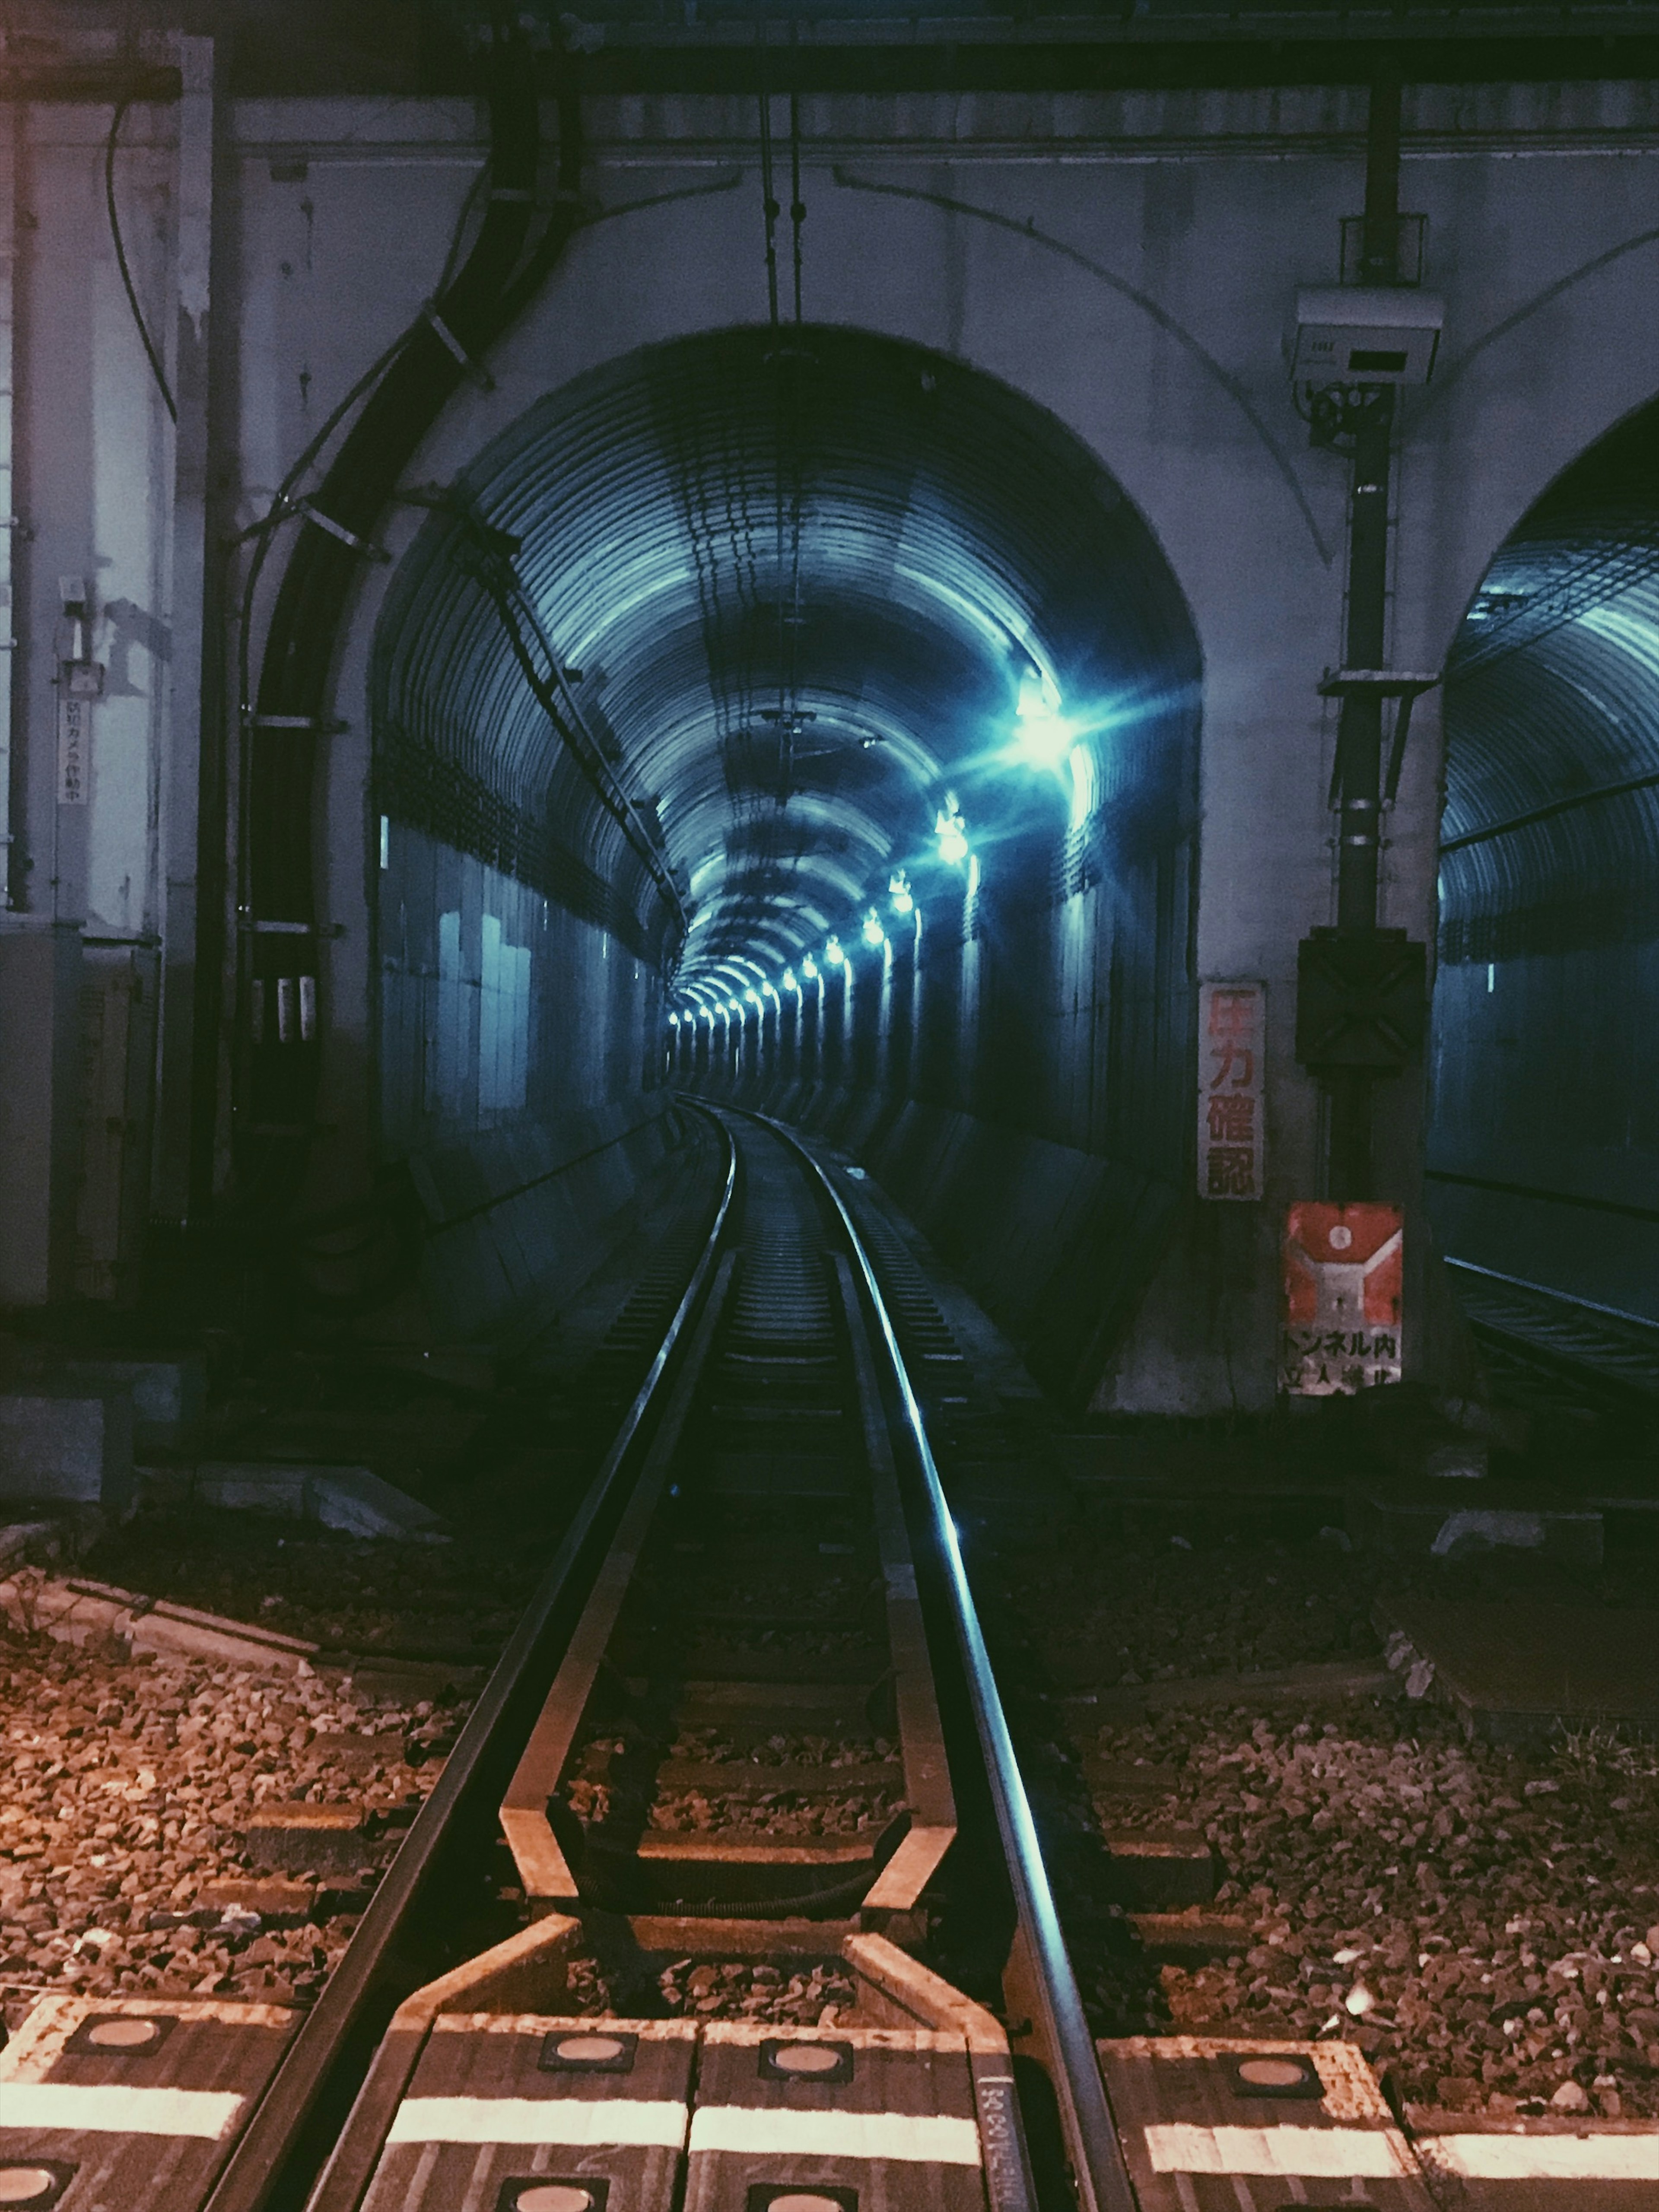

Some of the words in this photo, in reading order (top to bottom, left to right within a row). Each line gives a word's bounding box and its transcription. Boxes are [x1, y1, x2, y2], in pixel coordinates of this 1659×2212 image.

[1207, 988, 1256, 1196] 圧力確認
[1283, 1330, 1396, 1359] トンネル内
[1283, 1363, 1392, 1388] 立入止
